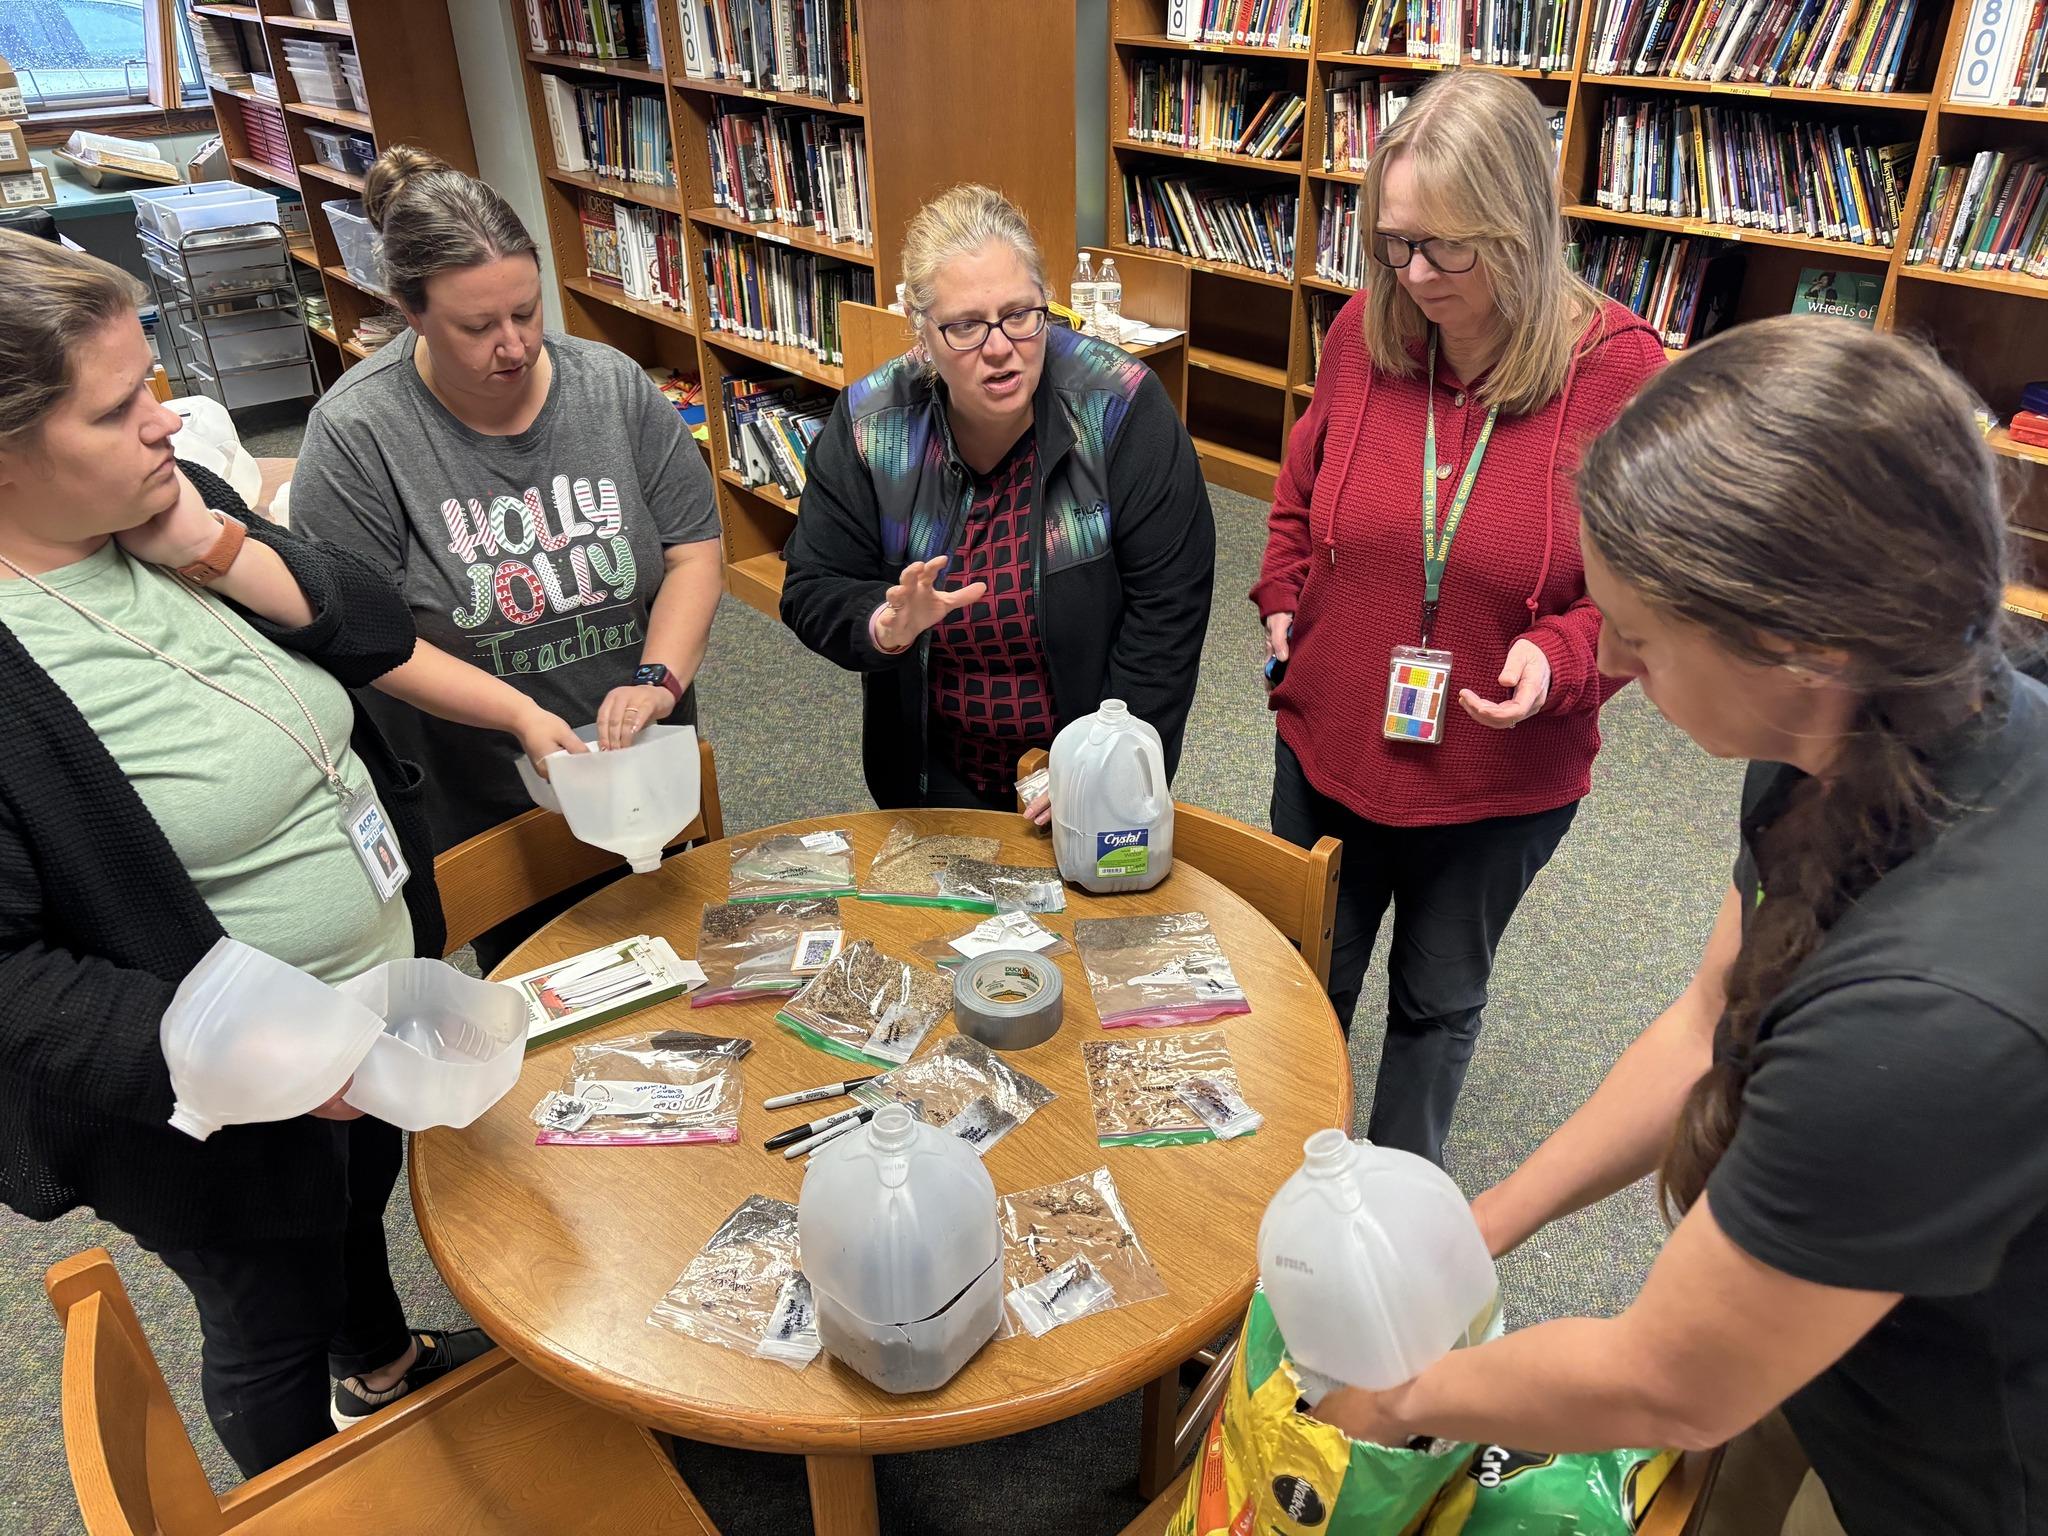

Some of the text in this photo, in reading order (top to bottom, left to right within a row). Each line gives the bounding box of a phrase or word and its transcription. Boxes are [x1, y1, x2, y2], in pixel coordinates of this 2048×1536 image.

[1647, 23, 1662, 51] music
[1967, 0, 2003, 86] 800
[549, 95, 565, 159] 100
[1882, 160, 1899, 228] Bicycling Dummies
[1995, 198, 2007, 216] LADDER
[619, 227, 632, 287] 200
[1858, 305, 1877, 320] of
[1480, 417, 1494, 443] MOUNT
[440, 474, 623, 564] HOLLY
[1073, 503, 1105, 517] FILA
[1425, 470, 1435, 561] MOUNT SAVAGE SCHOOL
[1437, 472, 1474, 561] MOUNT SAVAGE SCHOOL
[452, 535, 638, 629] JOLLY
[476, 615, 637, 677] Teacher
[358, 808, 378, 836] ACPS
[1104, 831, 1141, 847] Crystal
[654, 1083, 716, 1111] Ziploc
[1479, 1446, 1510, 1488] Gro
